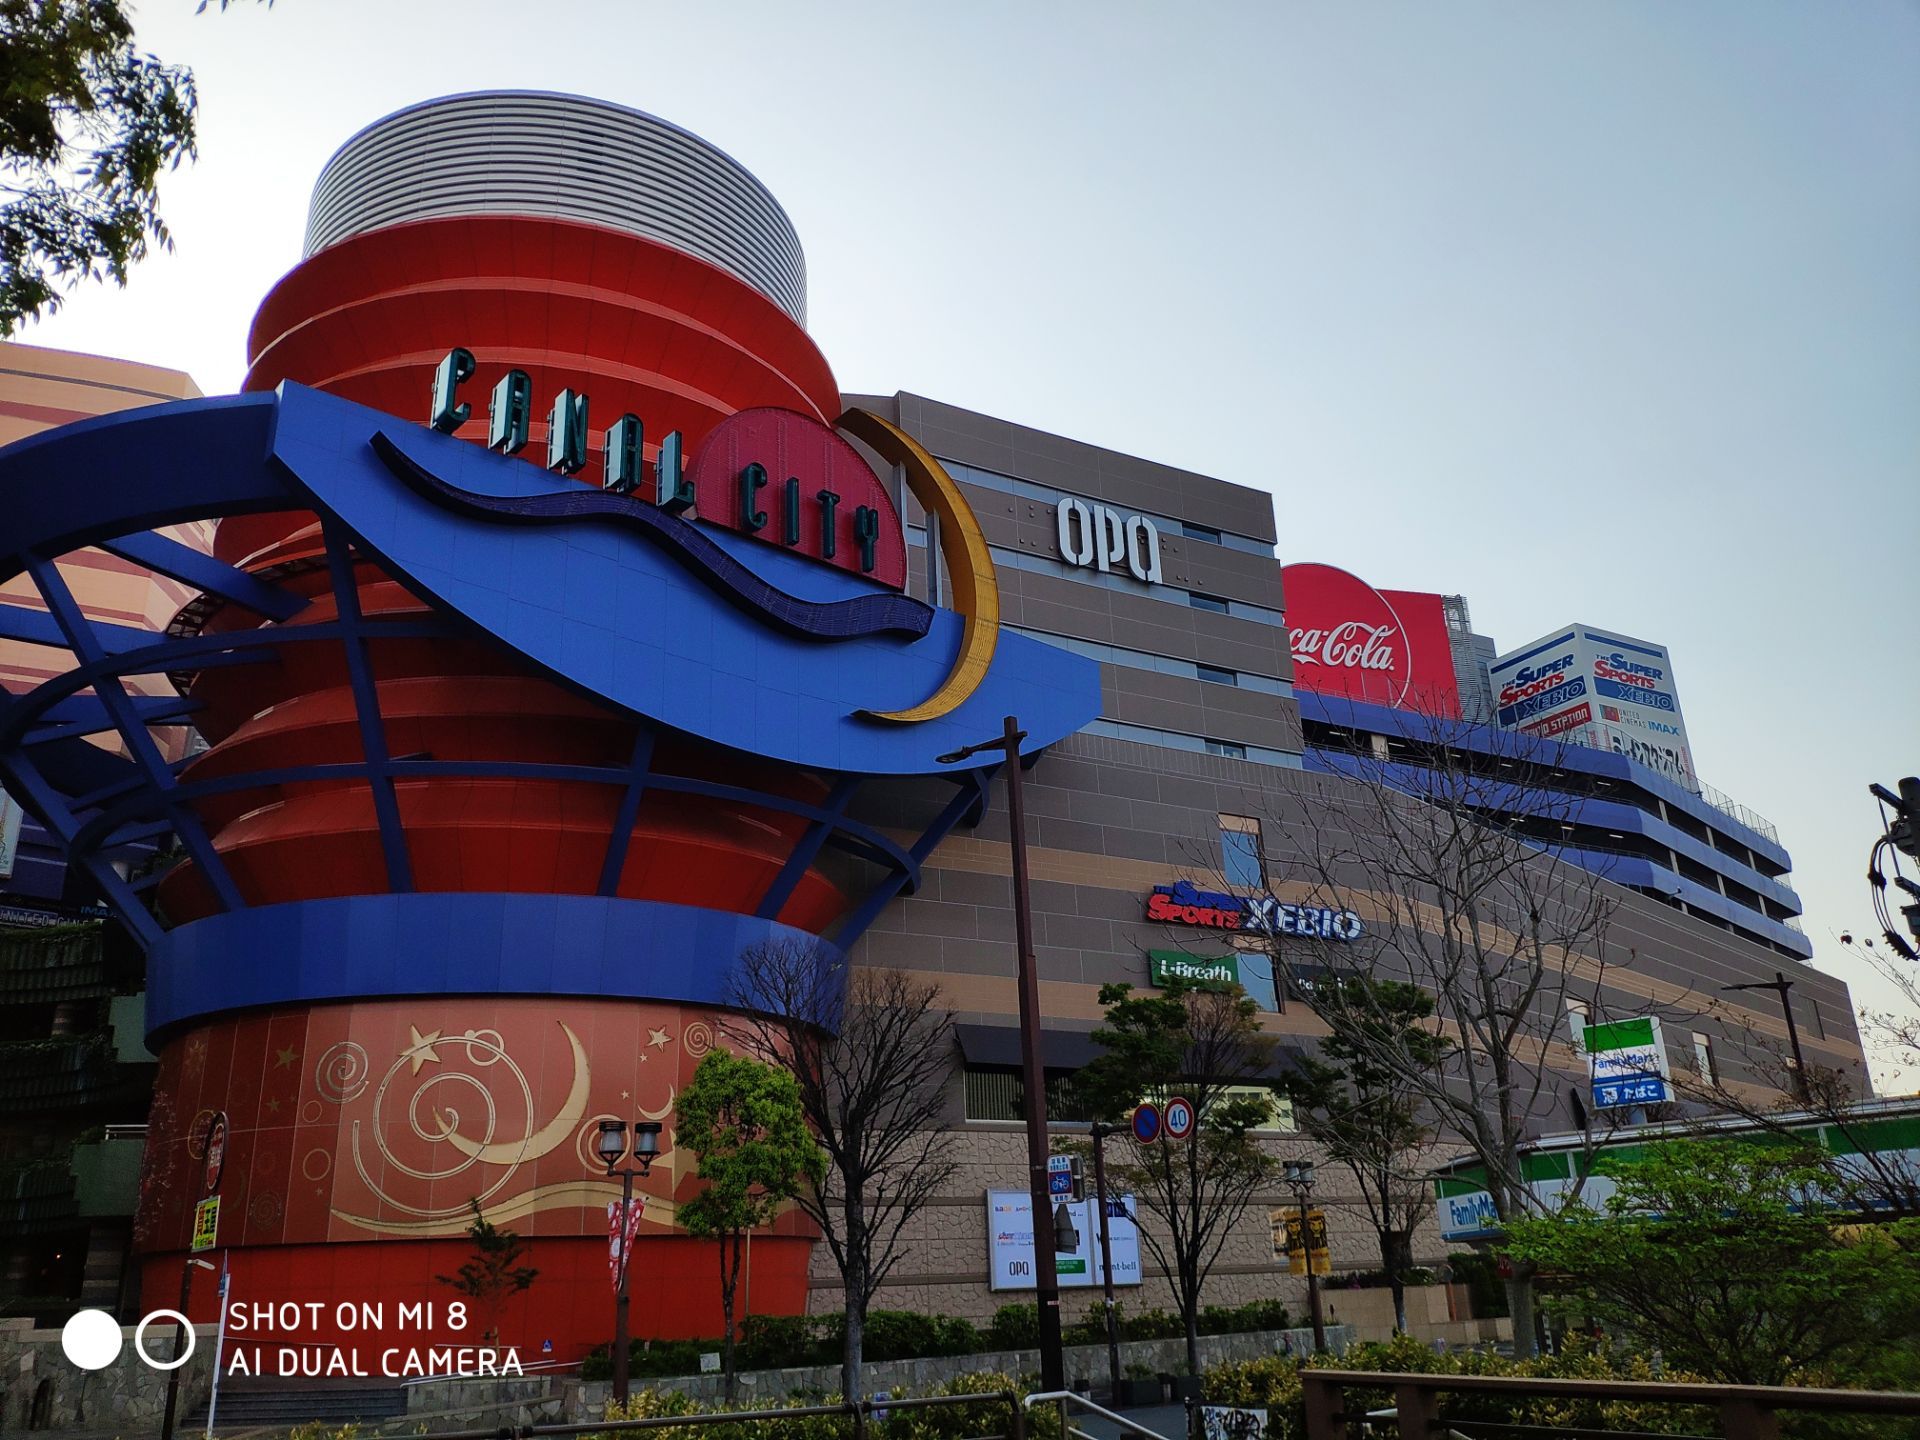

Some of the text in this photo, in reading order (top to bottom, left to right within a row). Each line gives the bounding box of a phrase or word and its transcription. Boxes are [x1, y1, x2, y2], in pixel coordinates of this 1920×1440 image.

[433, 348, 880, 574] CANAL CITY
[1289, 621, 1398, 670] ca-Cola
[1515, 653, 1574, 688] SUPER
[1594, 660, 1655, 689] SPORTS
[1596, 652, 1663, 680] THE SUPER
[1498, 670, 1565, 708] SPORTS
[1522, 680, 1585, 718] XEBIO
[1617, 685, 1671, 710] XEBIO
[1618, 708, 1641, 720] UNITED
[1620, 715, 1680, 737] CINEMAS IMAX
[1147, 893, 1361, 940] SPORTS XEBIO
[1160, 959, 1233, 982] L-Breath
[1623, 1084, 1659, 1100] たばこ
[1170, 1109, 1187, 1128] 40
[1449, 1193, 1497, 1227] FamilyMa
[1099, 1260, 1137, 1271] mnt-bell
